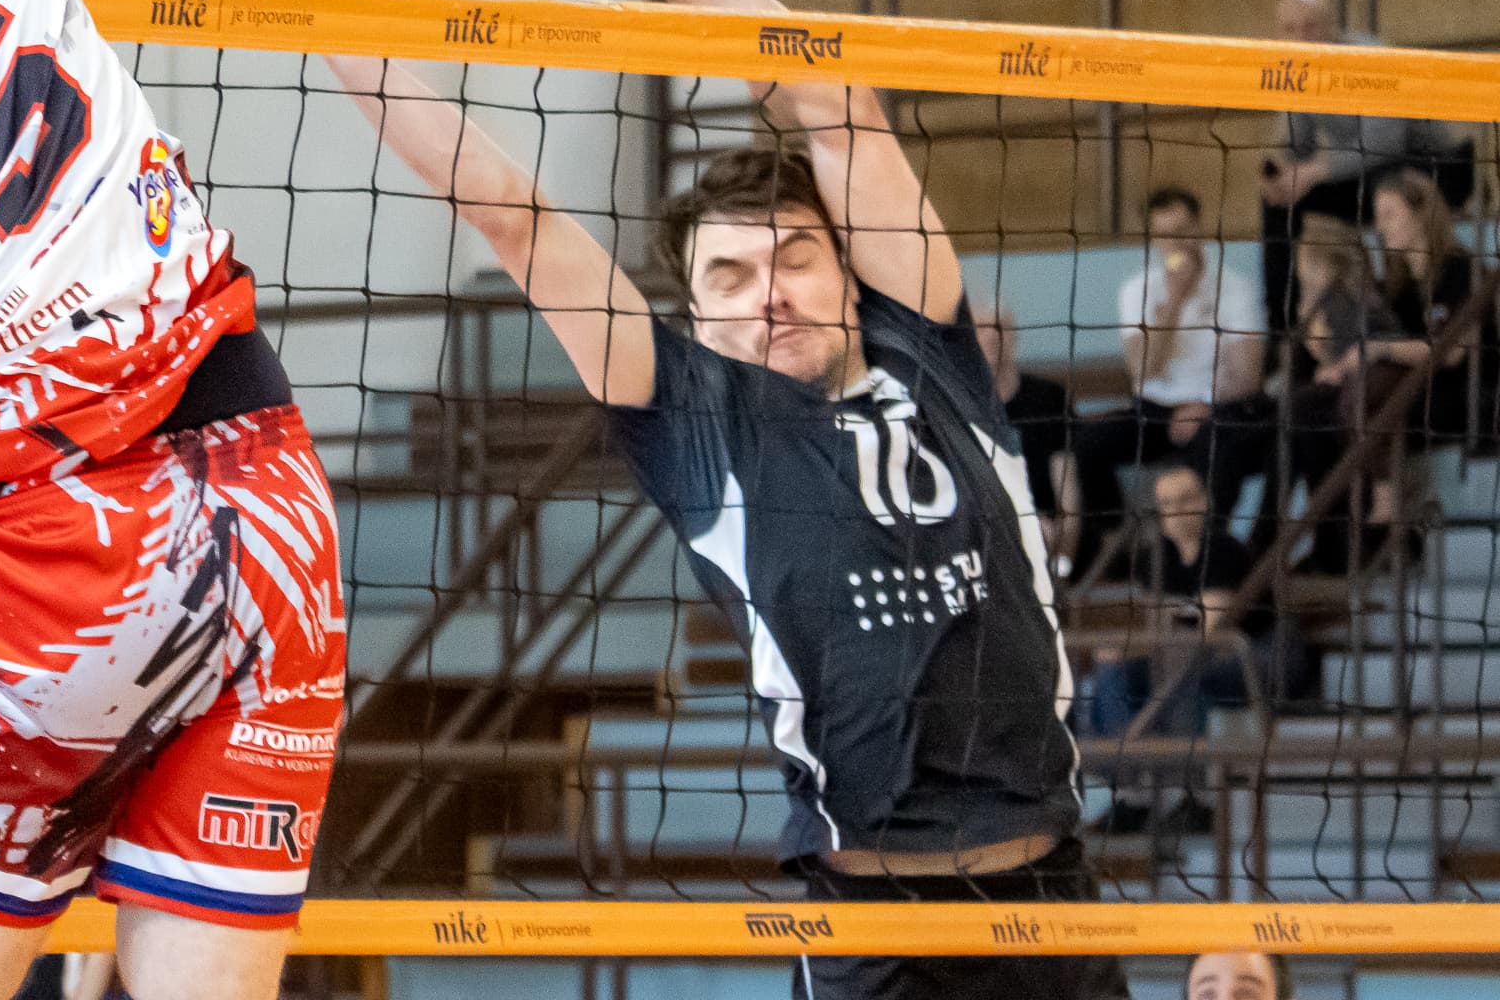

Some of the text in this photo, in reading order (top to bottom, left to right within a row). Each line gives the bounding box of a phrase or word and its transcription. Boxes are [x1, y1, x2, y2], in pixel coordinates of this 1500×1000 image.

[229, 10, 244, 26] je
[248, 8, 314, 27] tipovanie
[445, 7, 603, 45] niké je tipovanie
[999, 41, 1051, 77] niké
[1260, 59, 1311, 93] niké
[433, 911, 486, 943] niké
[990, 914, 1040, 943] niké
[1252, 912, 1301, 942] niké
